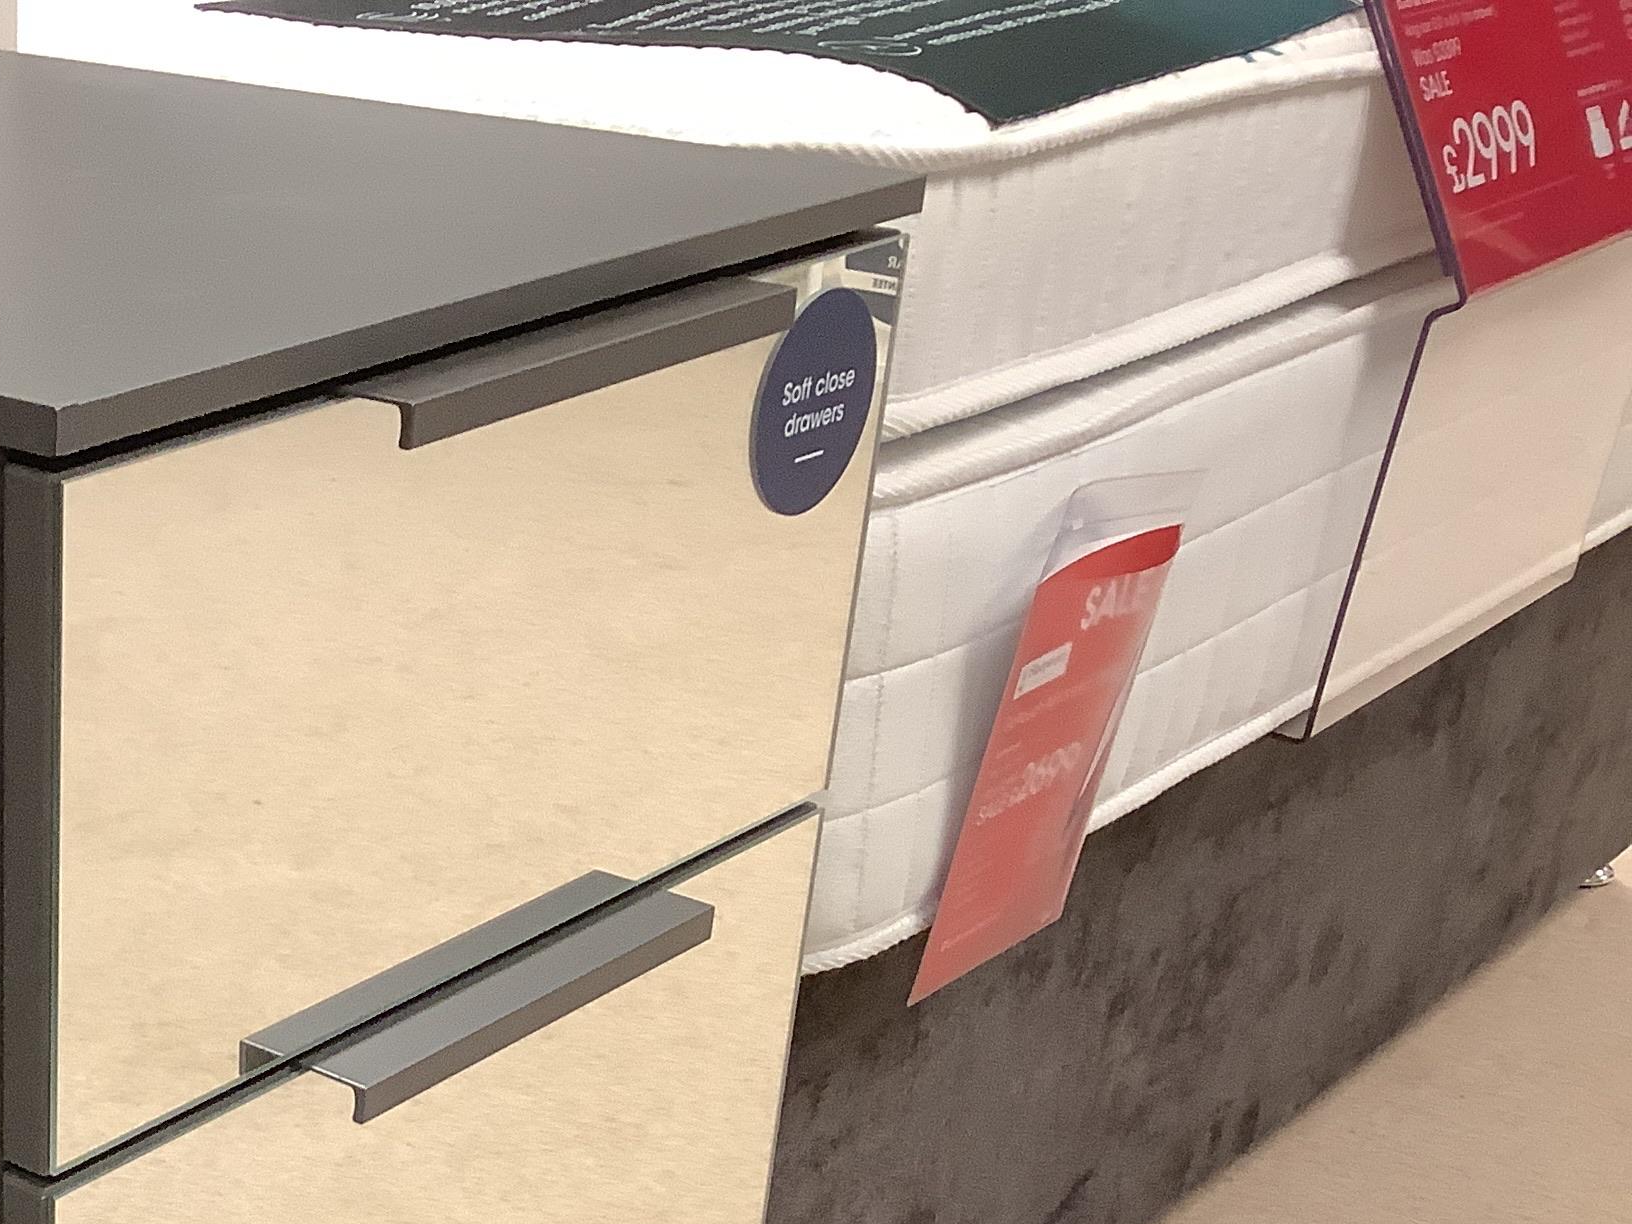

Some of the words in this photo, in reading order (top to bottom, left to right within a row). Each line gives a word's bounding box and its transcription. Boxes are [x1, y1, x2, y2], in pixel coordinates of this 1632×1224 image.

[1419, 70, 1453, 101] SALE
[1442, 99, 1536, 194] £2999
[782, 376, 813, 406] Soft
[815, 369, 855, 397] close
[784, 403, 845, 438] drawers
